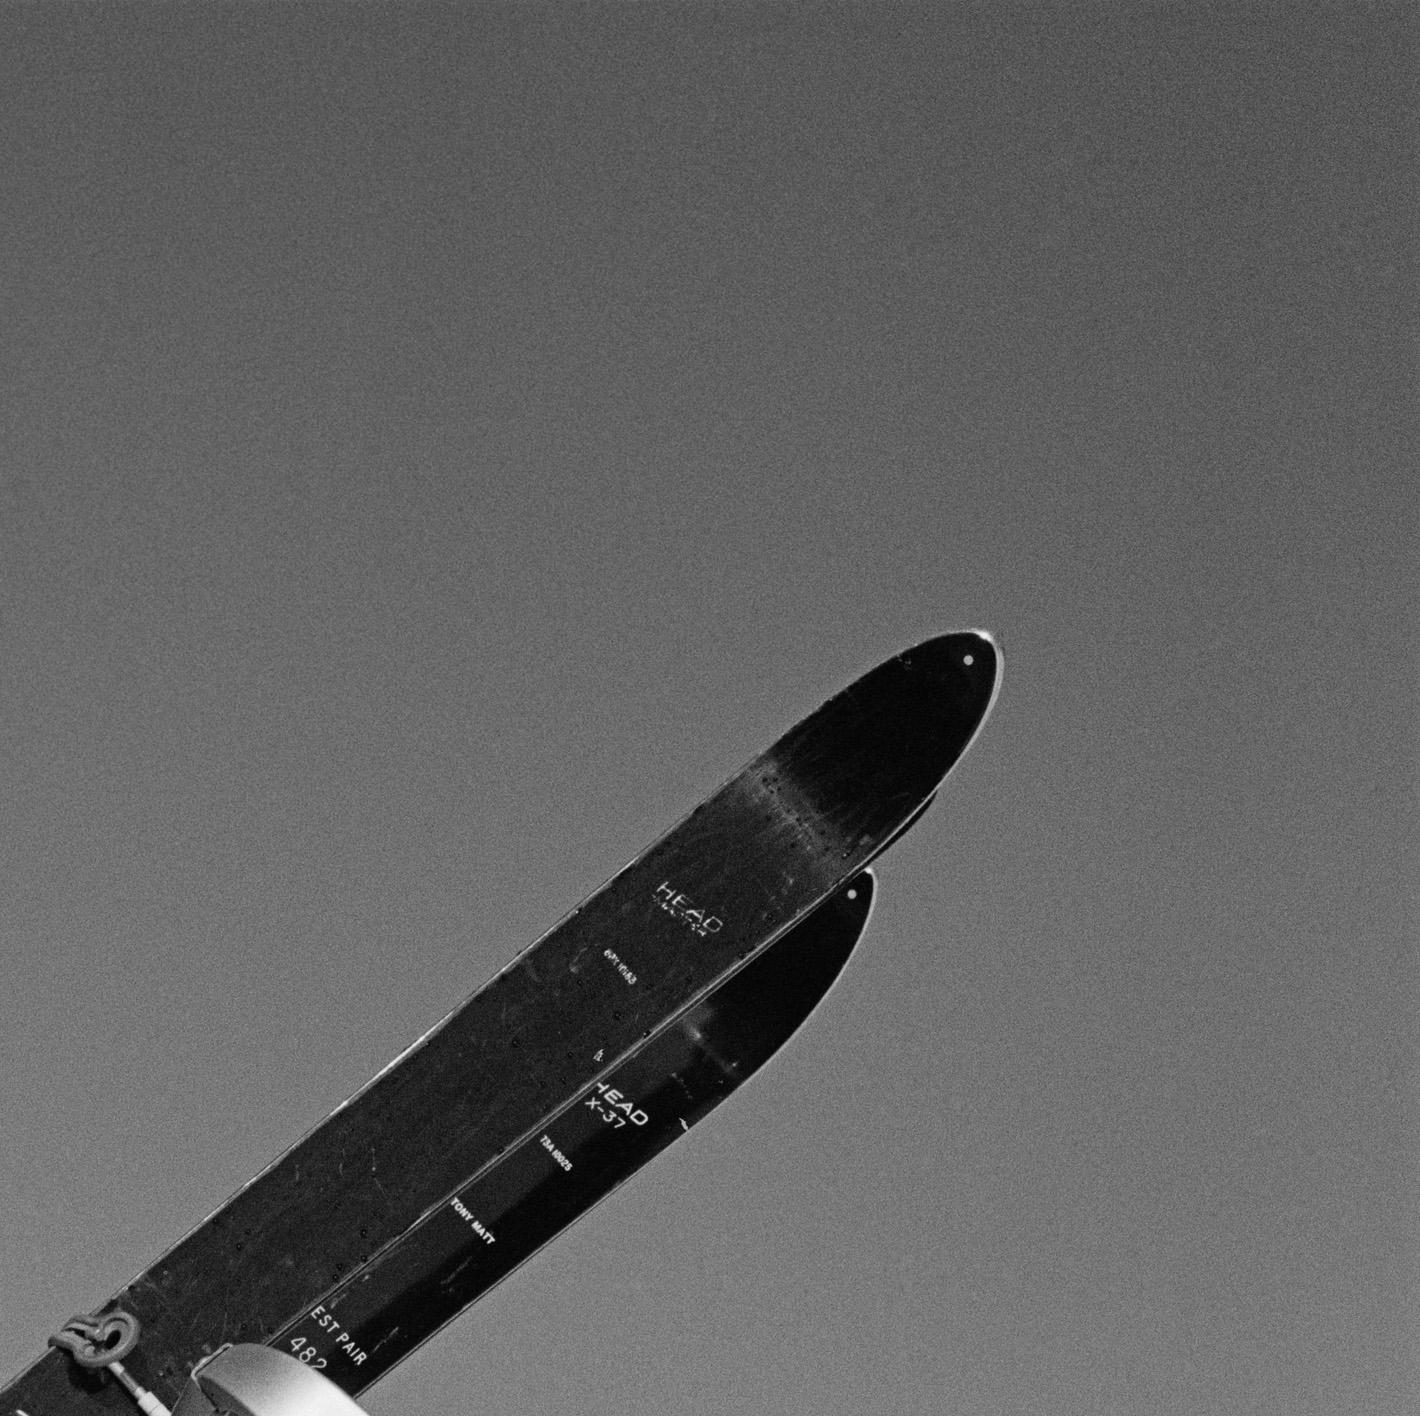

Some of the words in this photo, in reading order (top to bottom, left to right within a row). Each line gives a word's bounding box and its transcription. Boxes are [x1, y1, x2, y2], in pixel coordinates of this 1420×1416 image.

[656, 881, 723, 933] HEAD
[584, 1096, 626, 1129] X-37
[597, 1082, 649, 1126] HEAD
[450, 1196, 475, 1221] TONY
[471, 1220, 496, 1245] MATT
[310, 1305, 340, 1333] EST
[335, 1332, 368, 1366] PAIR
